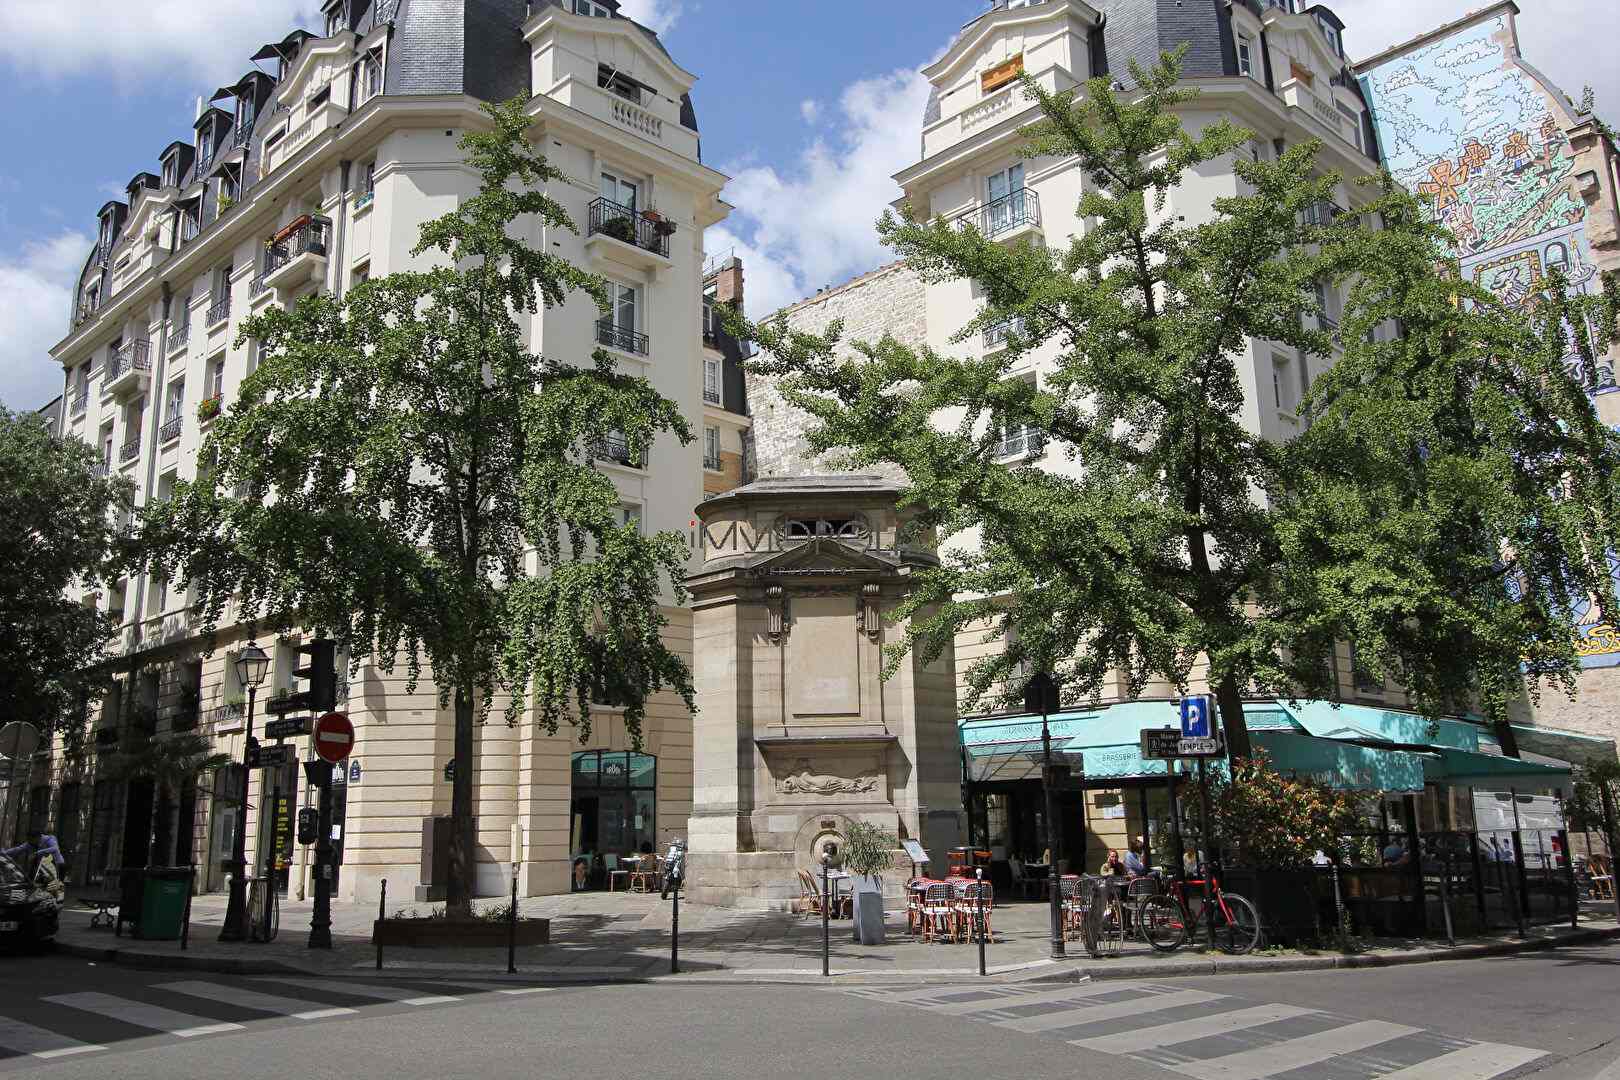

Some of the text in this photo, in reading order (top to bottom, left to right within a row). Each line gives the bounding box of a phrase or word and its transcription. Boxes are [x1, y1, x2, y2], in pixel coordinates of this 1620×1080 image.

[1187, 704, 1200, 731] P
[1179, 742, 1203, 751] TEMPLE
[1102, 753, 1137, 761] BRASSERIE
